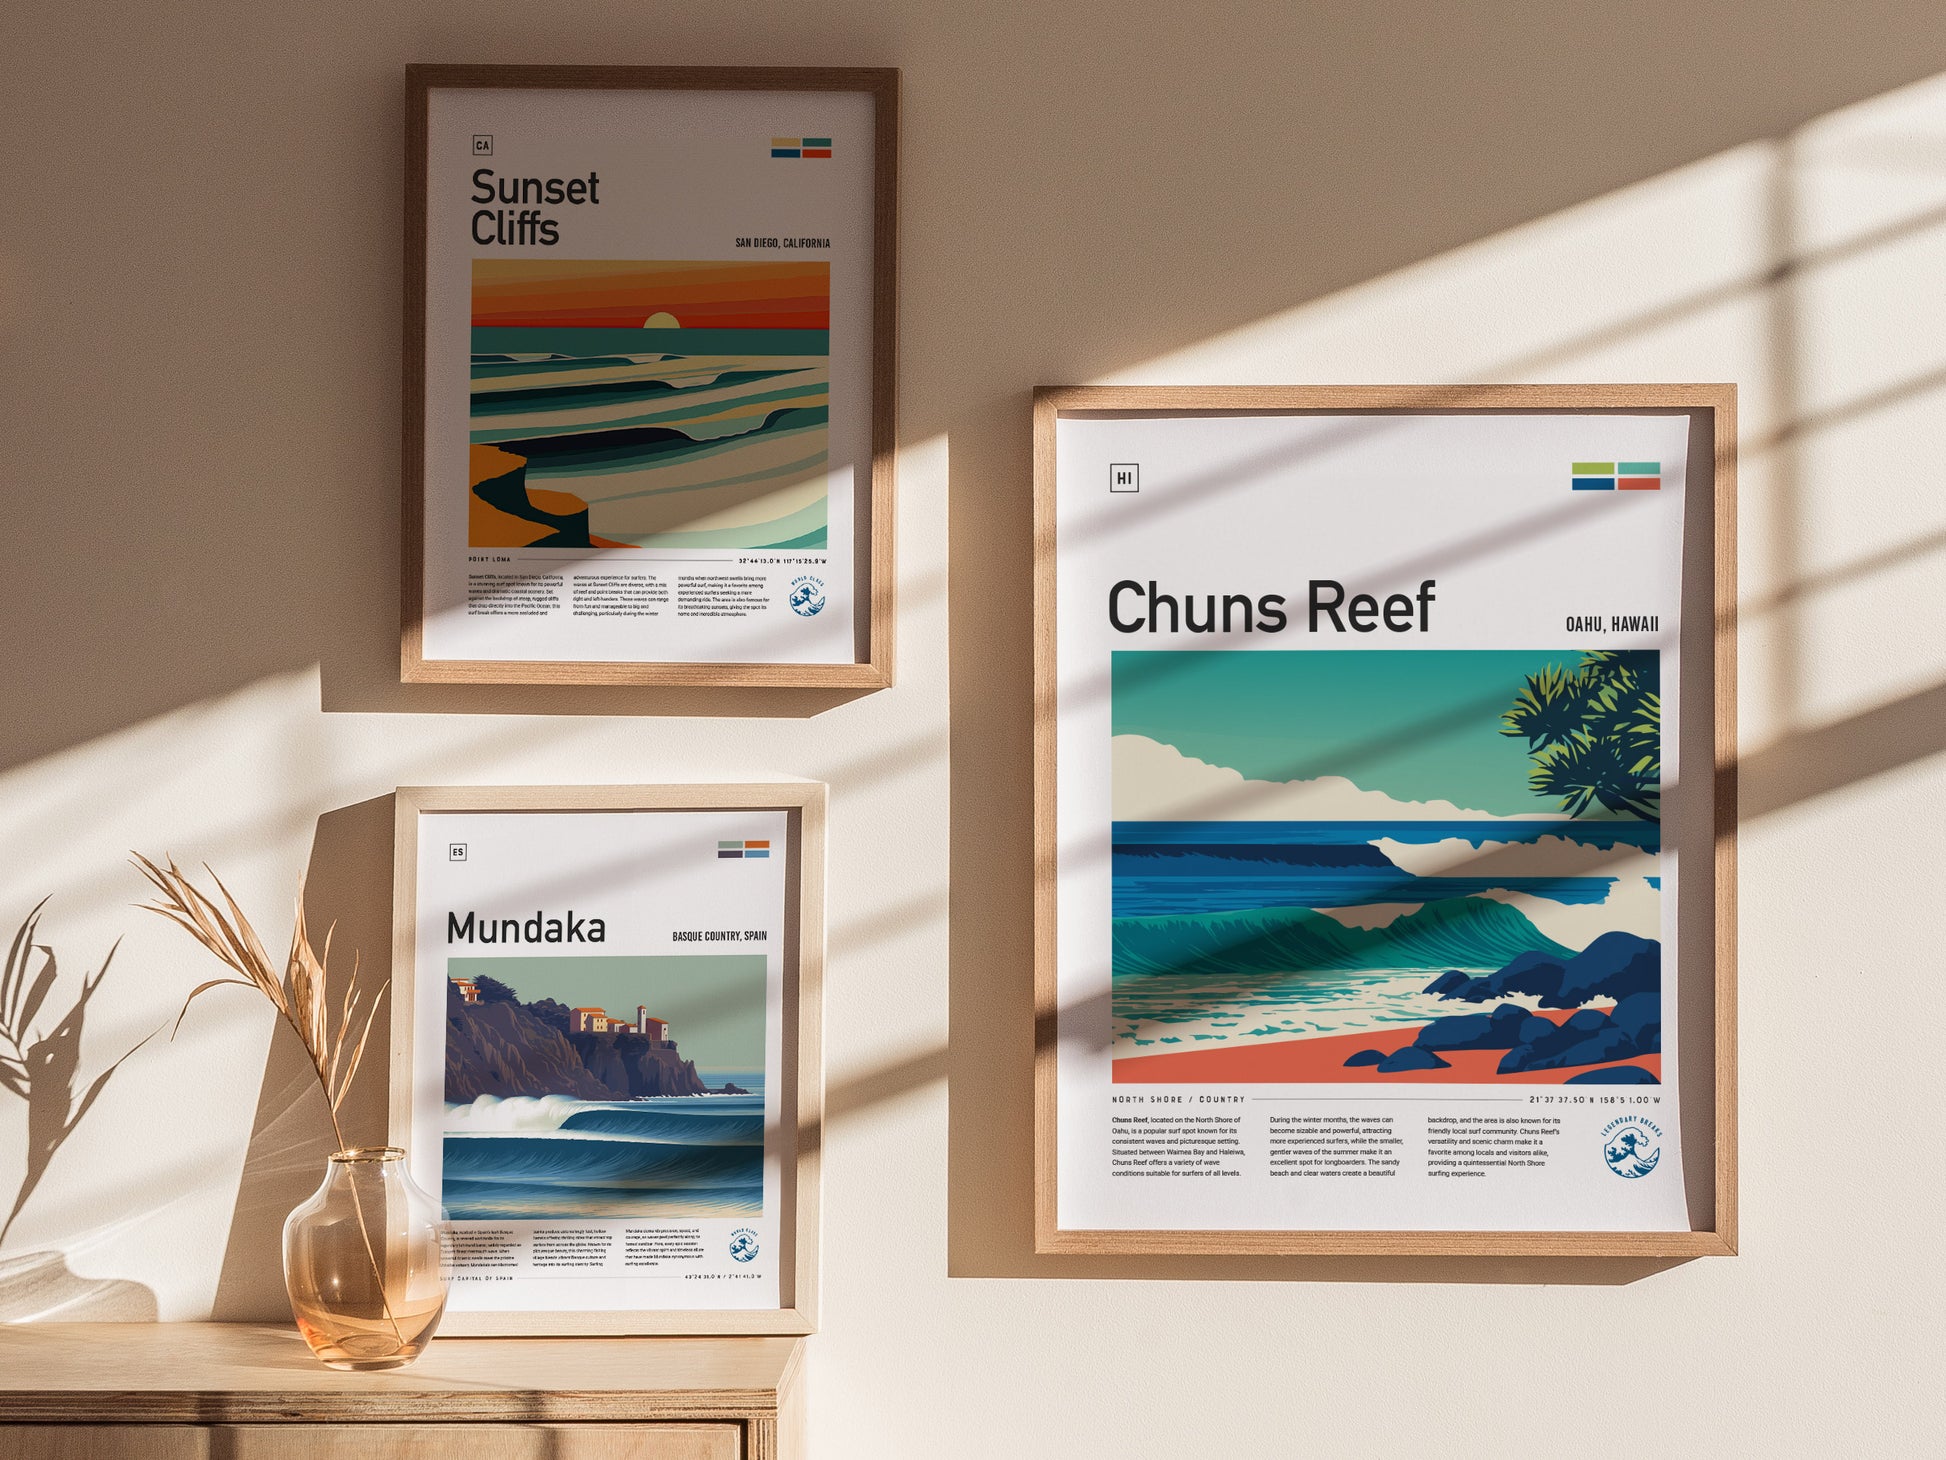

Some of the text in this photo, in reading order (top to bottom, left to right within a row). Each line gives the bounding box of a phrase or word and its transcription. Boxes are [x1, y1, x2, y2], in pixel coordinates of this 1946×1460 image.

[476, 140, 489, 151] CA
[471, 169, 599, 204] Sunset
[472, 210, 559, 246] Cliffs
[736, 237, 830, 249] SAN DIEGO, CALIFORNIA
[1118, 472, 1131, 484] HI
[493, 555, 510, 563] LOMA
[1109, 580, 1435, 633] Chuns Reef
[1566, 616, 1658, 634] OAHU, HAWAII
[453, 847, 463, 857] ES
[448, 910, 605, 944] Mundaka
[673, 930, 767, 942] BASQUE COUNTRY, SPAIN
[1112, 1095, 1144, 1104] NORTH
[1151, 1095, 1182, 1104] SHORE
[1200, 1095, 1244, 1104] COUNTRY
[1112, 1116, 1132, 1124] Chuns
[1134, 1116, 1149, 1125] Reef,
[1151, 1116, 1174, 1124] located
[1184, 1116, 1194, 1124] the
[1196, 1116, 1213, 1124] North
[1215, 1116, 1233, 1124] Shore
[1270, 1116, 1290, 1125] During
[1292, 1116, 1302, 1124] the
[1303, 1116, 1322, 1124] winter
[1323, 1116, 1348, 1125] months,
[1428, 1116, 1458, 1125] backdrop,
[1506, 1117, 1519, 1125] also
[1521, 1117, 1541, 1125] known
[1542, 1117, 1552, 1125] for
[1600, 1115, 1663, 1138] LEGENDARY BREAKS
[1112, 1127, 1130, 1136] Oahu,
[1144, 1127, 1167, 1135] popular
[1168, 1127, 1180, 1135] surf
[1182, 1127, 1196, 1135] spot
[1197, 1127, 1218, 1135] known
[1270, 1127, 1295, 1135] become
[1296, 1127, 1318, 1135] sizable
[1332, 1127, 1361, 1135] powerful,
[1362, 1127, 1392, 1136] attracting
[1428, 1127, 1560, 1137] friendly local surf community. Chuns Reef's
[1112, 1137, 1144, 1145] consistent
[1167, 1137, 1178, 1145] and
[1180, 1137, 1216, 1146] picturesque
[1217, 1137, 1240, 1146] setting.
[1287, 1137, 1325, 1146] experienced
[1326, 1137, 1349, 1146] surfers,
[1351, 1137, 1367, 1145] while
[1368, 1137, 1378, 1145] the
[1380, 1137, 1403, 1145] smaller,
[1428, 1137, 1458, 1146] versatility
[1515, 1138, 1532, 1146] make
[1112, 1148, 1138, 1156] Situated
[1167, 1148, 1192, 1156] Waimea
[1193, 1148, 1204, 1157] Bay
[1206, 1148, 1218, 1156] and
[1219, 1148, 1245, 1157] Haleiwa,
[1270, 1148, 1291, 1157] gentler
[1322, 1148, 1332, 1156] the
[1360, 1148, 1377, 1156] make
[1428, 1148, 1451, 1156] favorite
[1453, 1149, 1474, 1157] among
[1496, 1149, 1507, 1157] and
[1509, 1149, 1531, 1157] visitors
[1533, 1149, 1548, 1158] alike,
[1112, 1158, 1132, 1166] Chuns
[1133, 1158, 1147, 1166] Reef
[1149, 1158, 1167, 1166] offers
[1174, 1159, 1194, 1167] variety
[1299, 1159, 1312, 1167] spot
[1324, 1158, 1366, 1167] longboarders.
[1368, 1158, 1380, 1166] The
[1381, 1159, 1400, 1167] sandy
[1428, 1159, 1456, 1168] providing
[1463, 1159, 1506, 1167] quintessential
[1508, 1159, 1526, 1167] North
[1527, 1159, 1545, 1167] Shore
[1112, 1169, 1144, 1177] conditions
[1146, 1169, 1170, 1177] suitable
[1182, 1169, 1204, 1177] surfers
[1222, 1169, 1241, 1177] levels.
[1270, 1169, 1289, 1177] beach
[1290, 1169, 1302, 1177] and
[1304, 1169, 1318, 1177] clear
[1368, 1169, 1395, 1177] beautiful
[1428, 1169, 1486, 1178] surfing experience.
